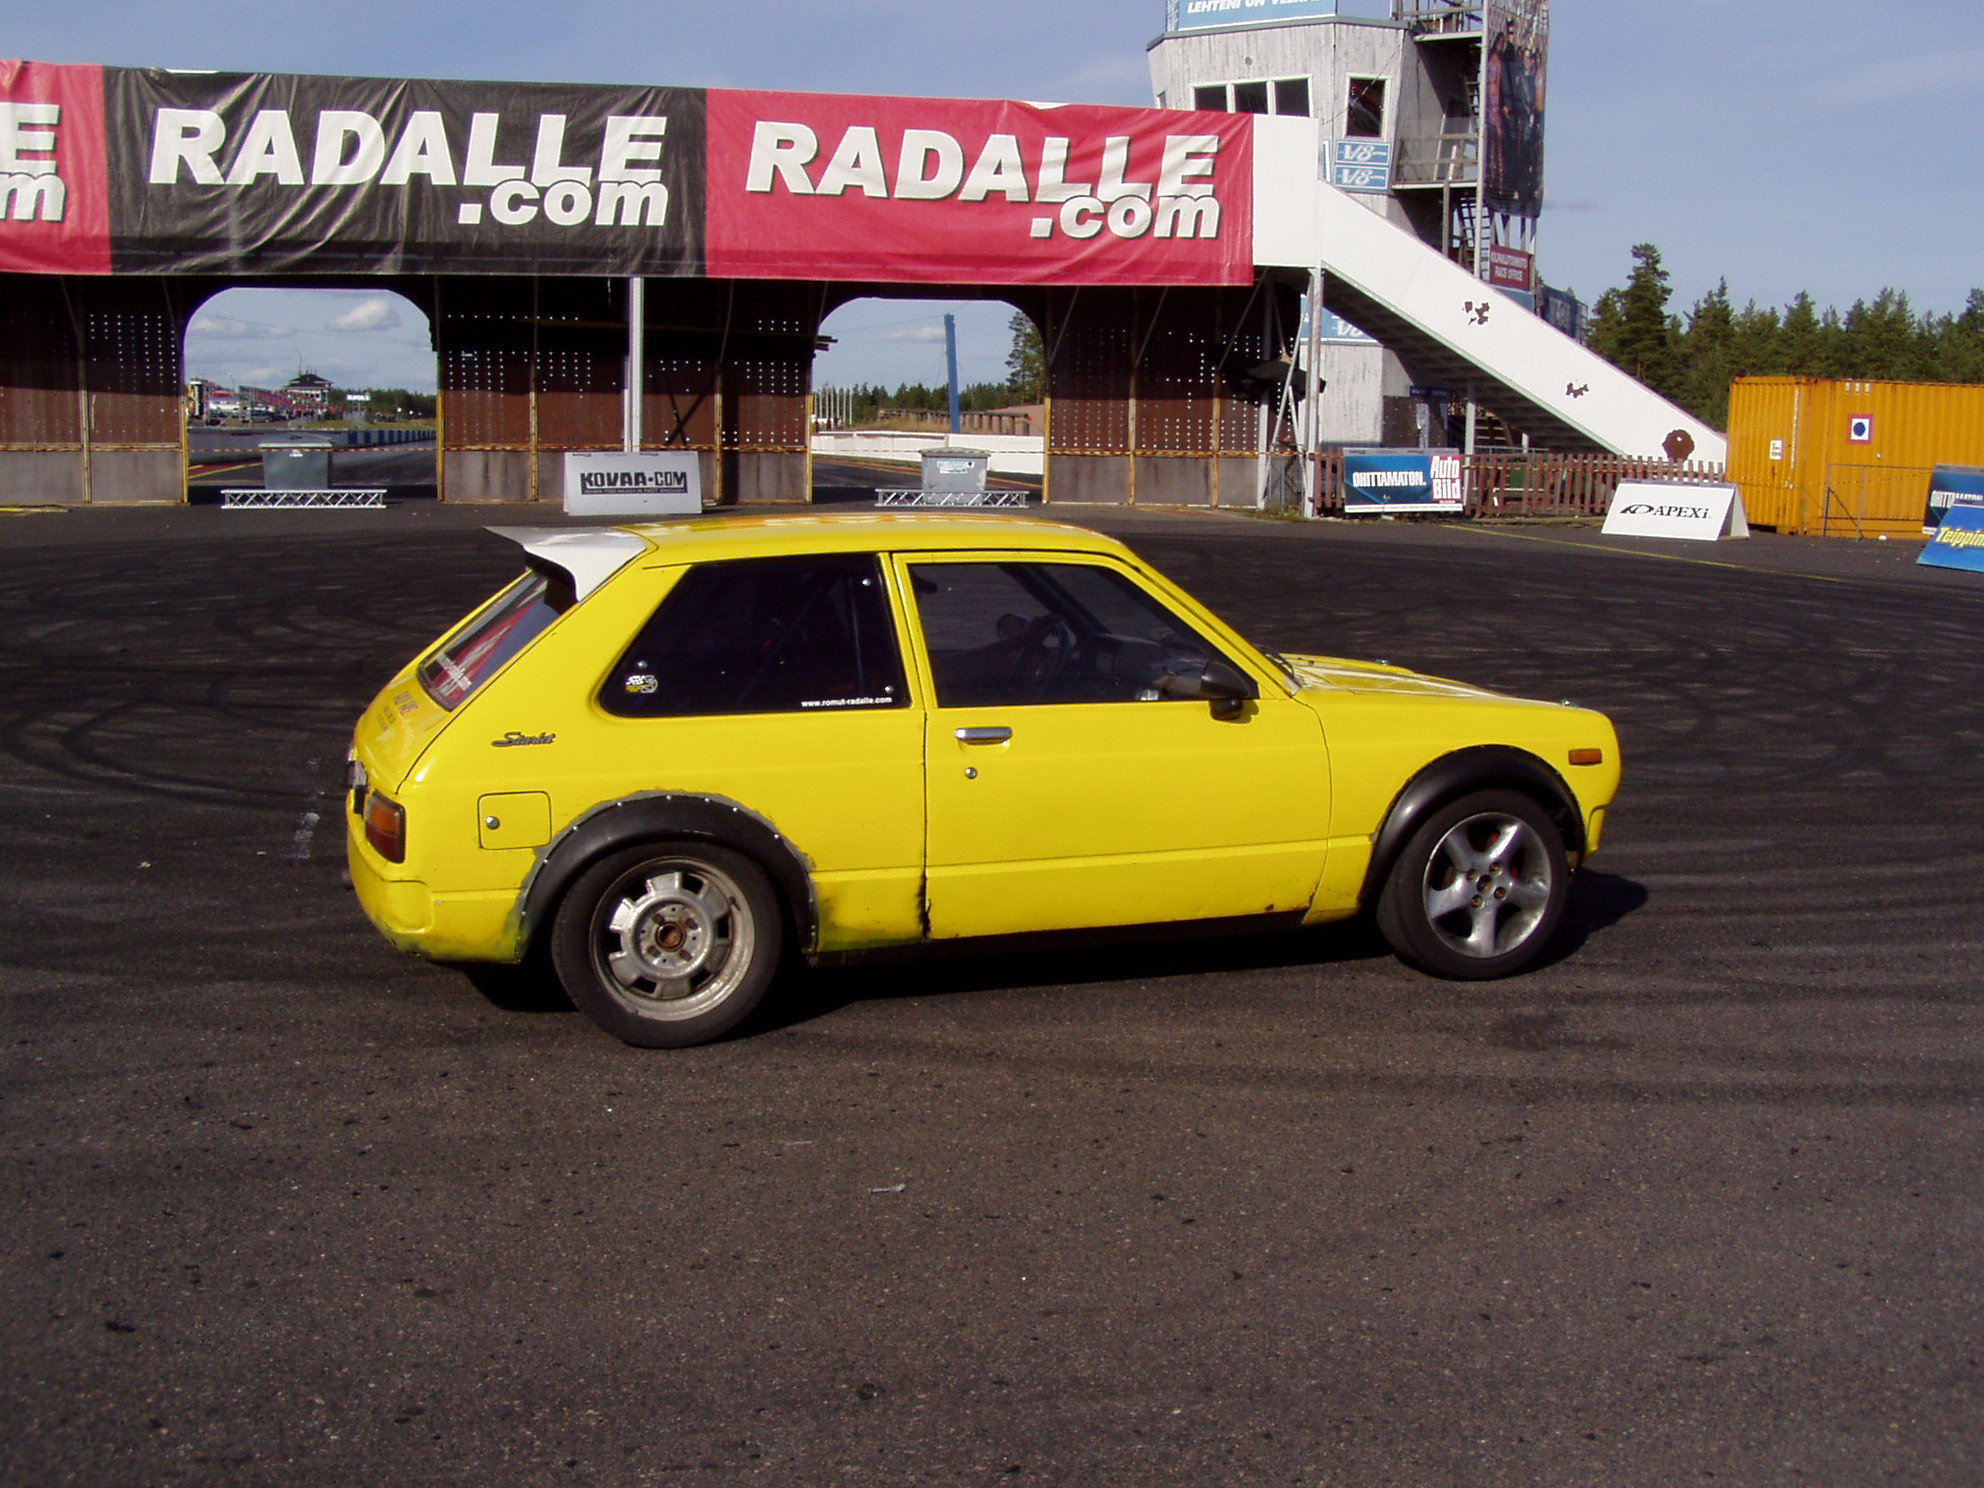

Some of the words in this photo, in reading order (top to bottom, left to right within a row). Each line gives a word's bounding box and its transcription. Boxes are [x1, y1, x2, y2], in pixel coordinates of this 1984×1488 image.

[149, 108, 667, 188] RADALLE
[1344, 144, 1377, 161] V8
[746, 120, 1219, 203] RADALLE
[1342, 168, 1374, 186] V8
[458, 180, 668, 226] .com
[1030, 194, 1222, 239] .com
[1430, 456, 1460, 479] Auto
[1352, 471, 1427, 488] OHITTAMATON.
[1432, 479, 1461, 500] Bild
